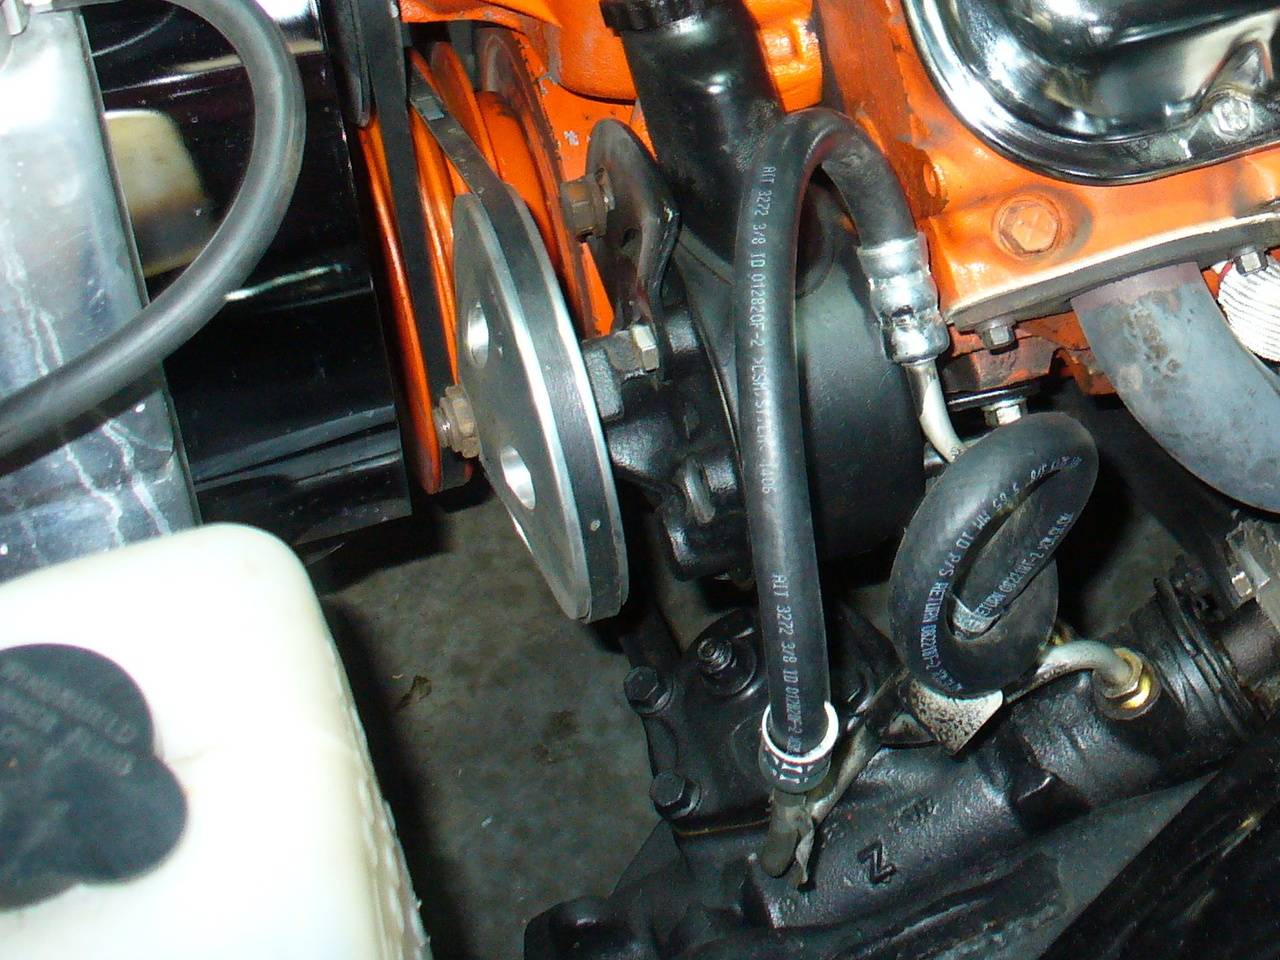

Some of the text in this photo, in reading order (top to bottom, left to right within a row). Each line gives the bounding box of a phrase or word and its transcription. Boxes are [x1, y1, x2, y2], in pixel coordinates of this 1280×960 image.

[753, 189, 773, 217] 3272
[750, 223, 767, 245] 3/8
[750, 253, 766, 268] ID
[775, 604, 795, 636] 3272
[780, 641, 798, 664] 3/8
